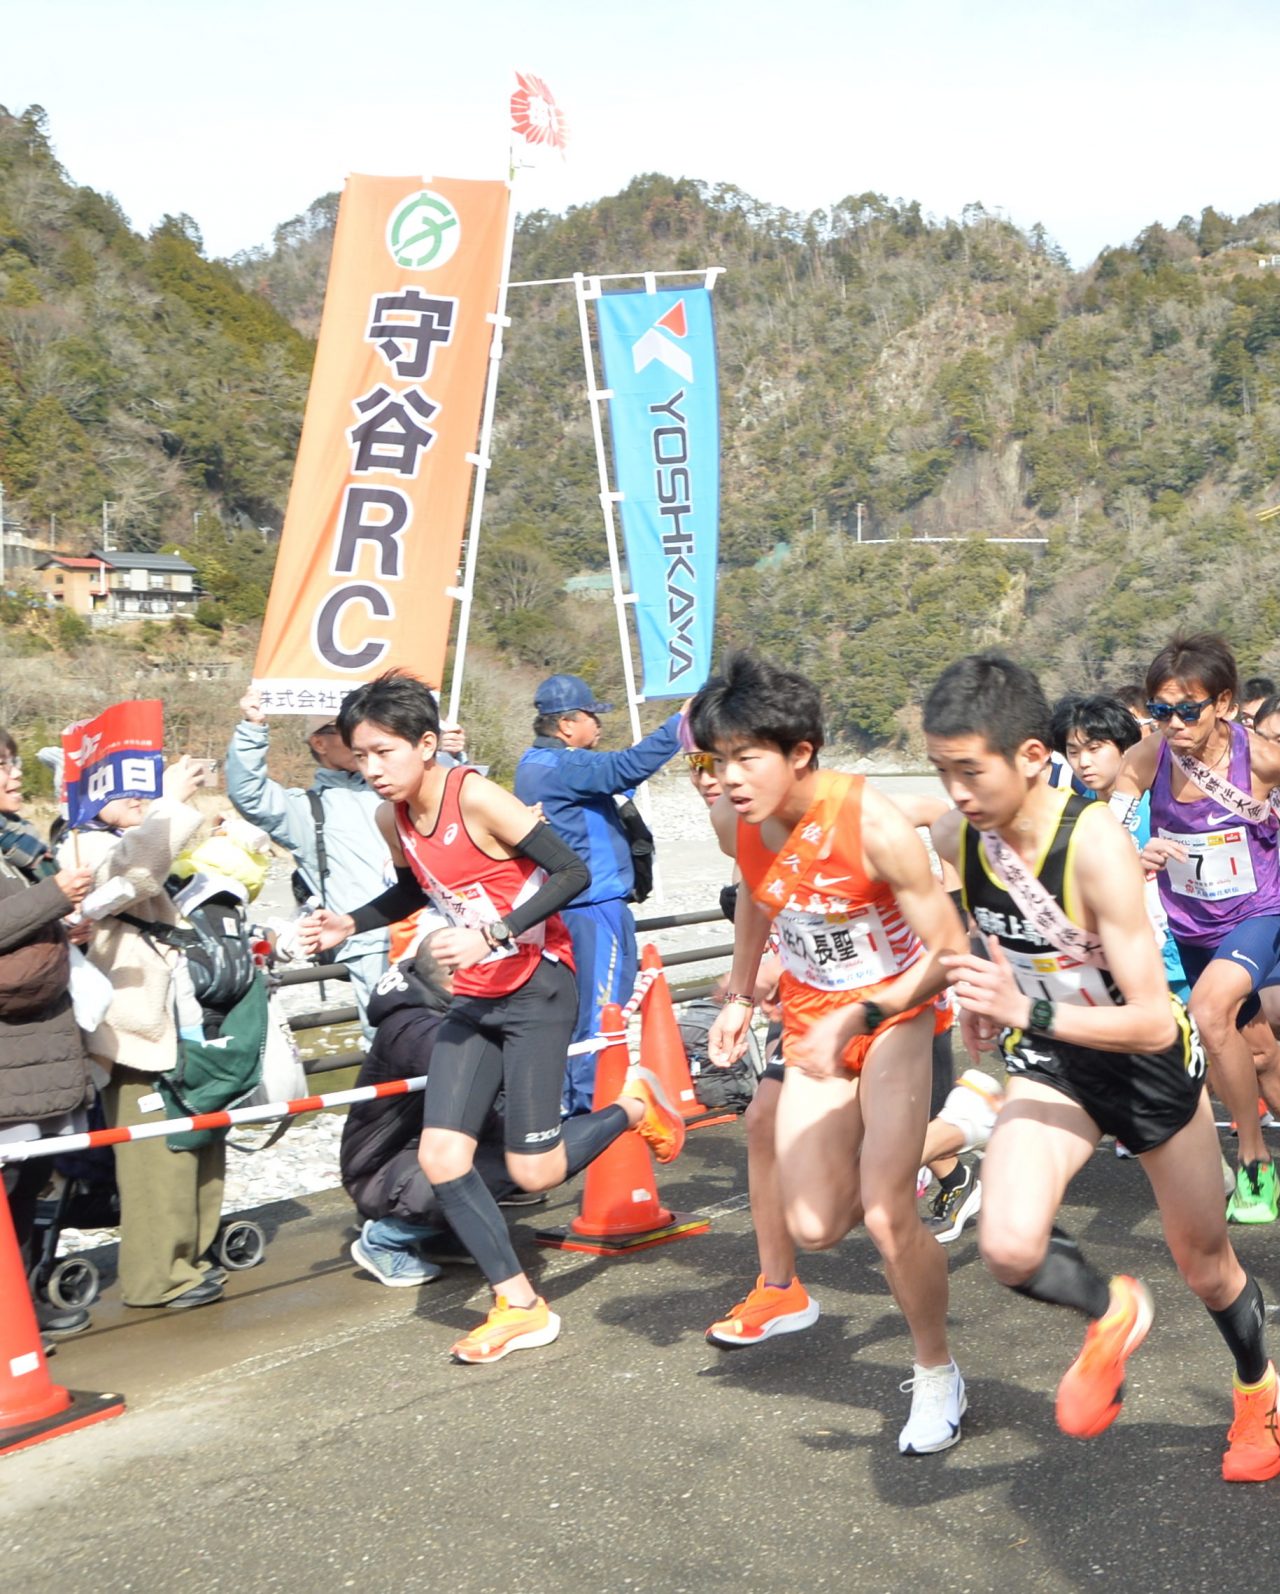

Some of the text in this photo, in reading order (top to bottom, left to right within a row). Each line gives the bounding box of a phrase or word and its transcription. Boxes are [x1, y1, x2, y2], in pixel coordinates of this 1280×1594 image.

[314, 288, 456, 671] 守谷RC
[260, 689, 353, 709] 株式会社
[88, 758, 156, 802] 中日
[1188, 853, 1204, 881] 7
[1229, 856, 1238, 876] 1
[866, 932, 877, 953] 1
